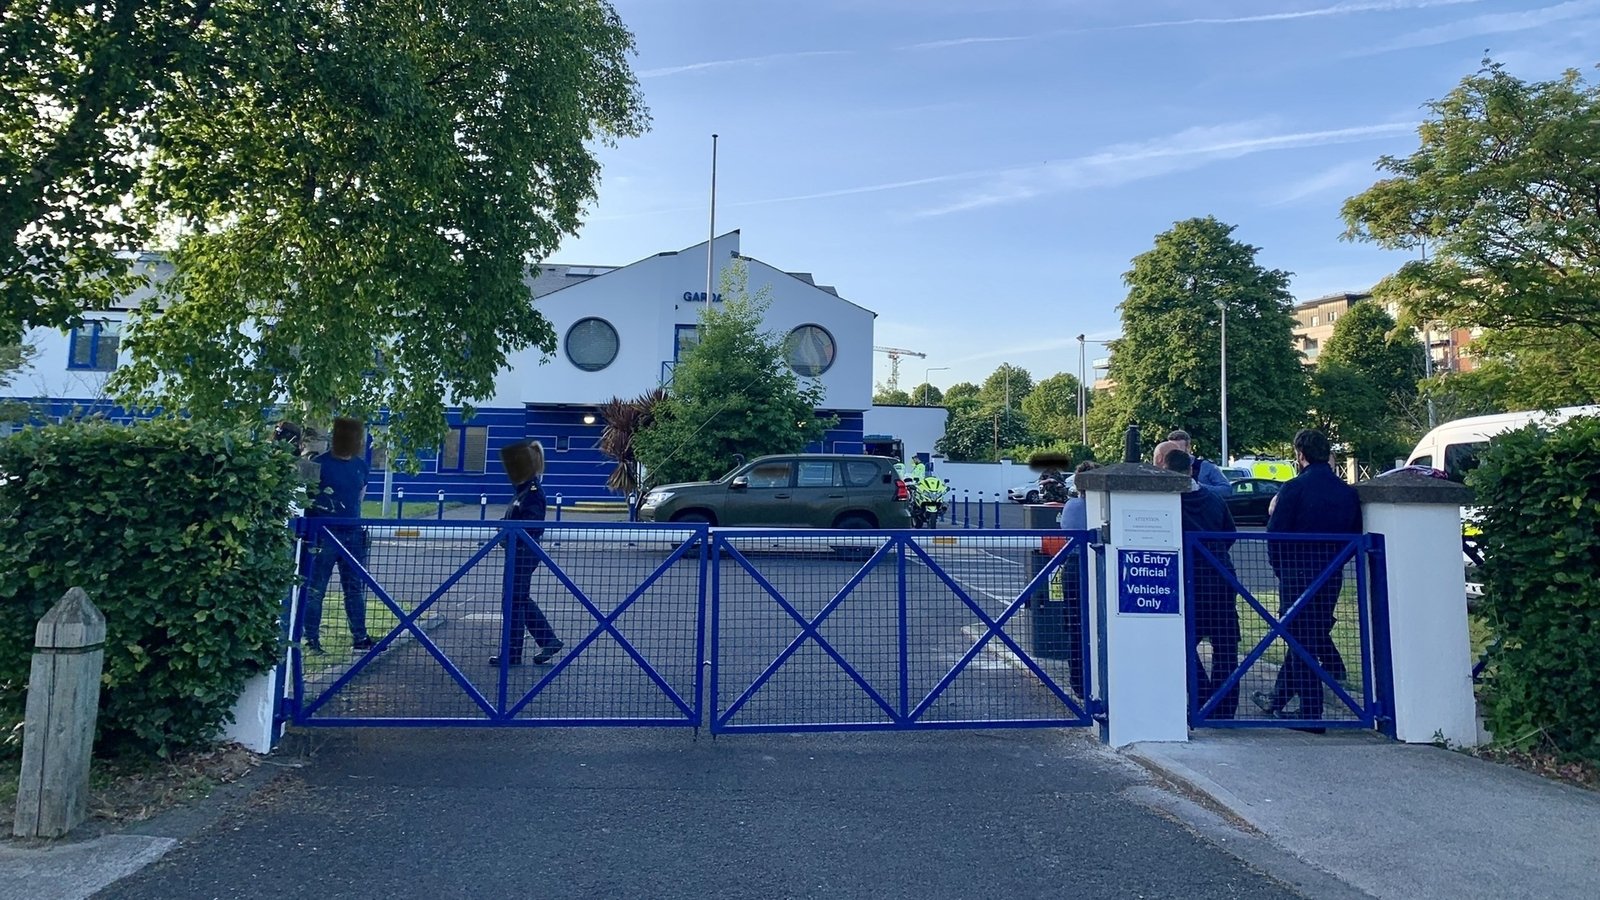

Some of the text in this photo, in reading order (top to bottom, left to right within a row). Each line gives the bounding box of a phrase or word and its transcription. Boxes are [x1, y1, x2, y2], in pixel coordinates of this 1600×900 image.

[1126, 554, 1171, 567] No Entry
[1130, 567, 1167, 577] Official
[1127, 584, 1171, 595] Vehicles
[1136, 598, 1161, 609] Only
